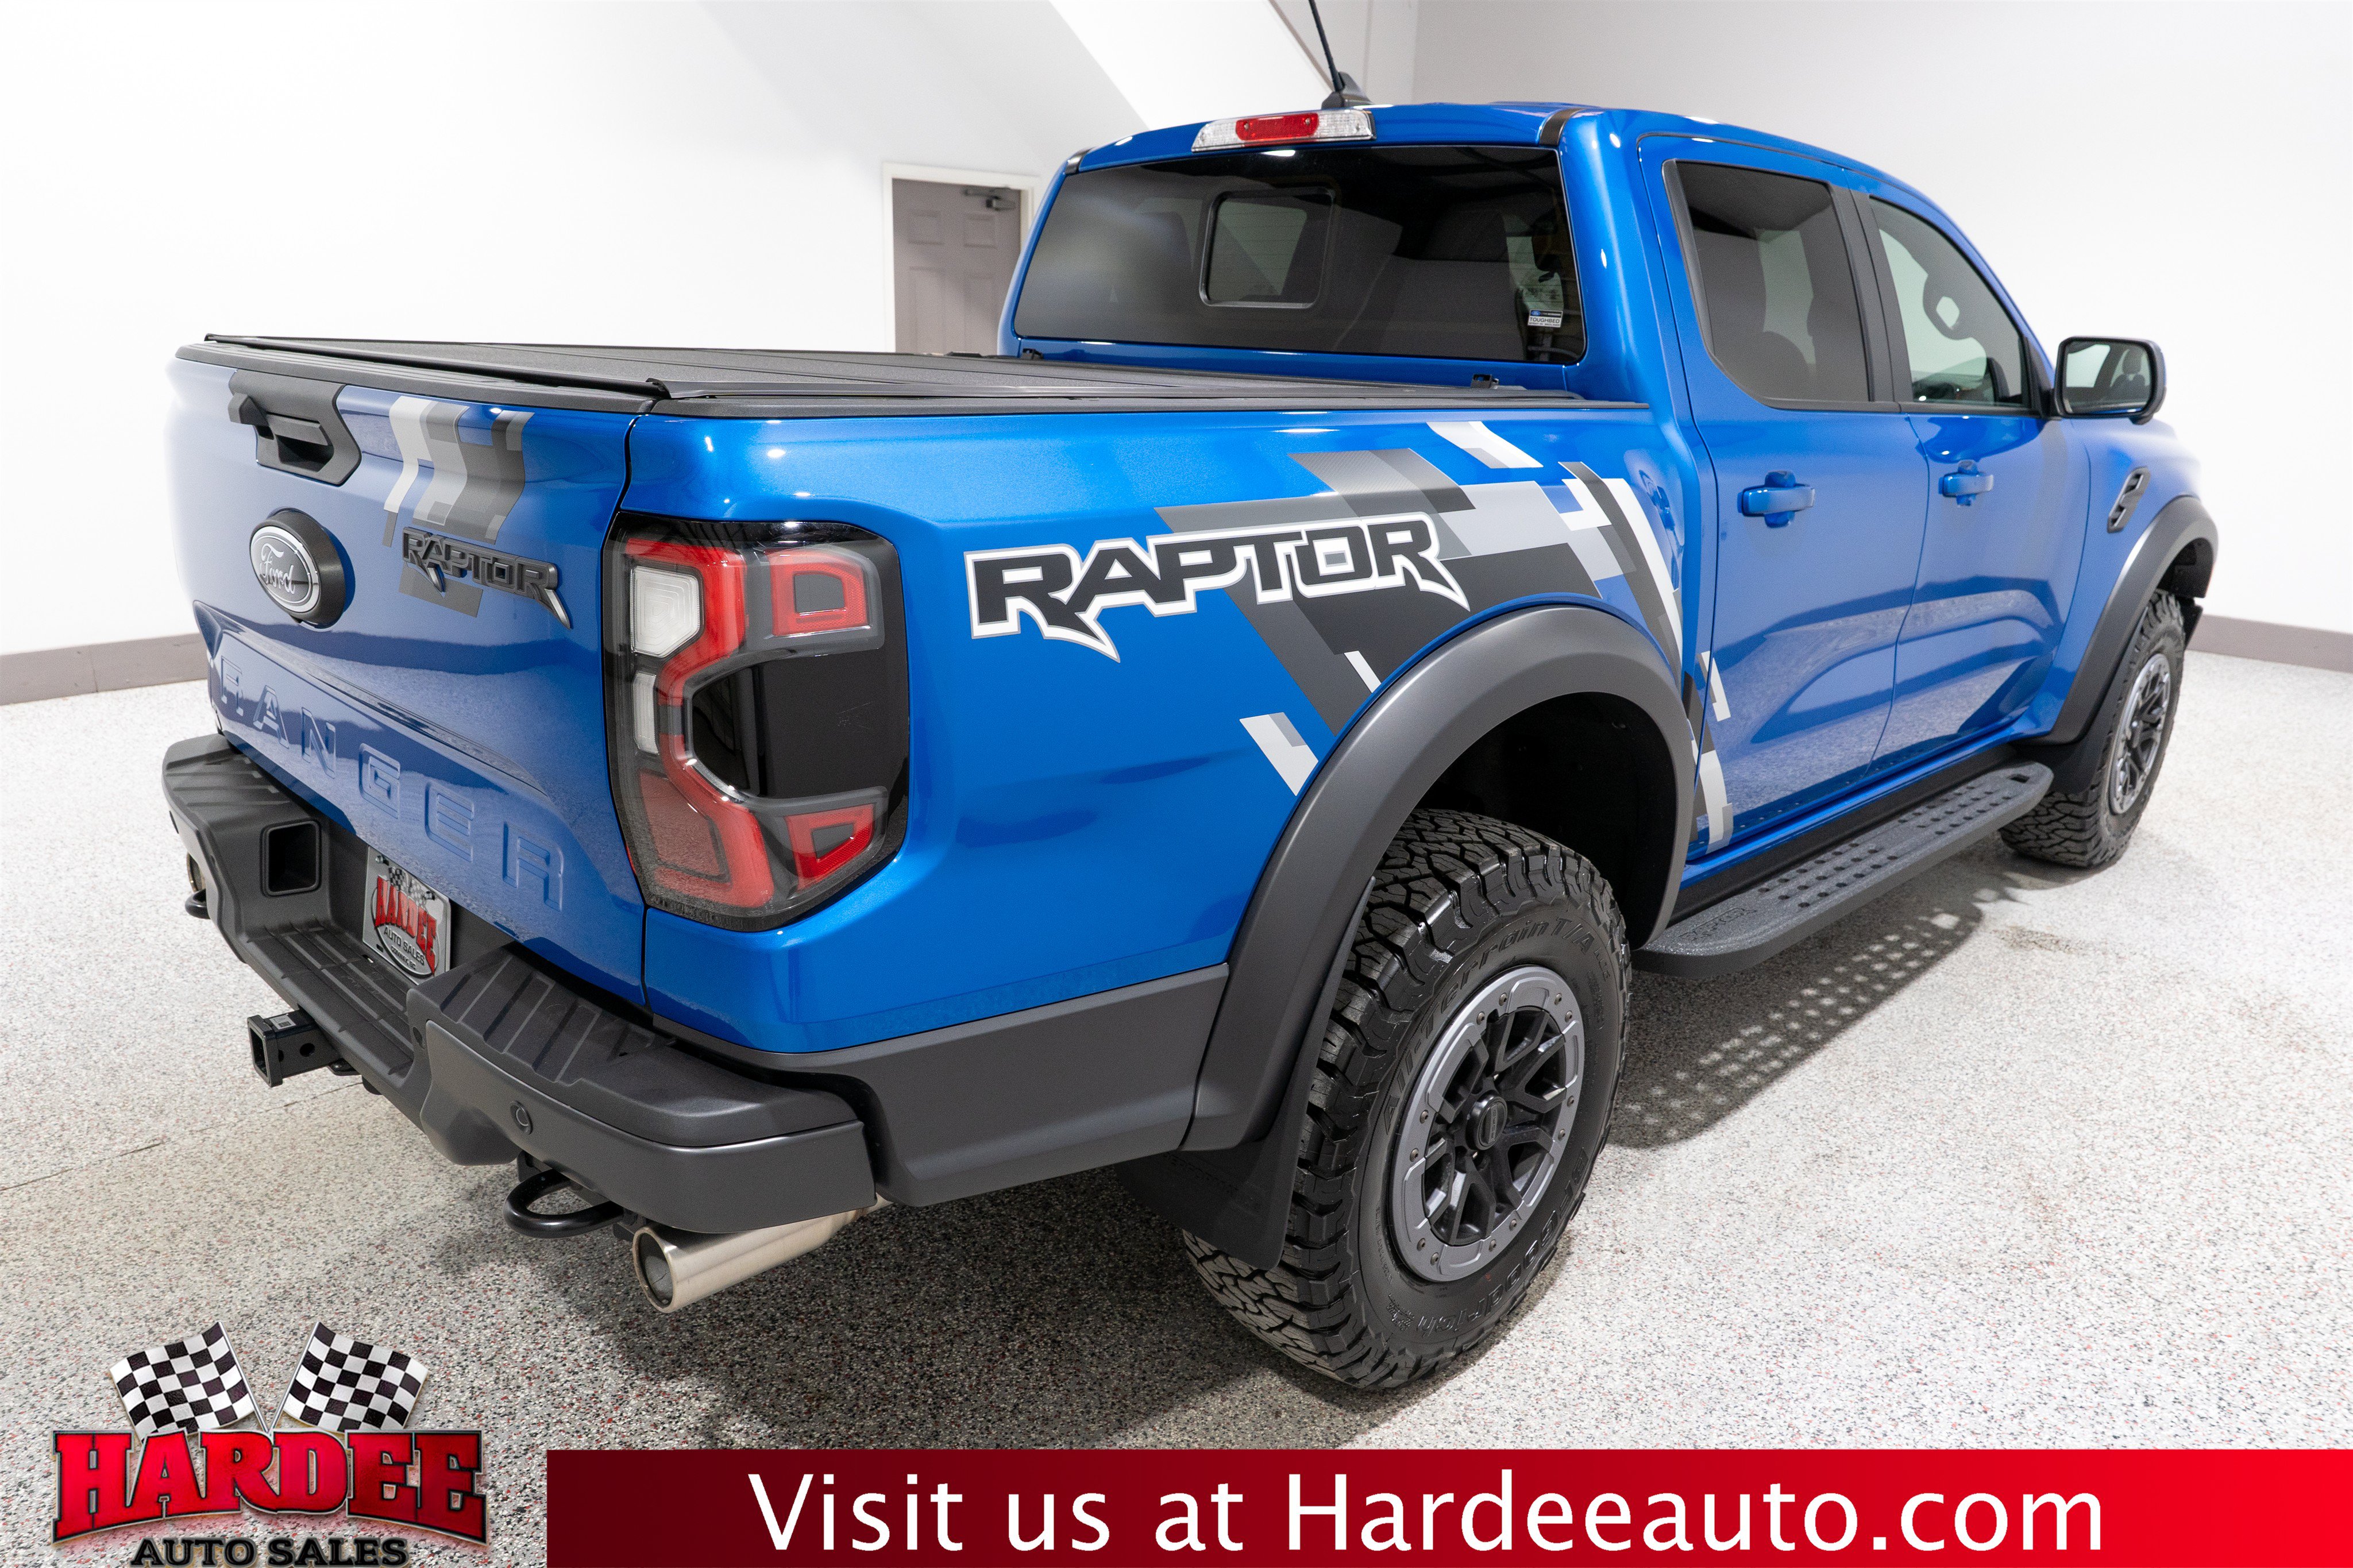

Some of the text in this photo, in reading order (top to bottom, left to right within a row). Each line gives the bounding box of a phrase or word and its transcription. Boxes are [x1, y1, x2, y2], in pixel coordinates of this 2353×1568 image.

[260, 542, 298, 594] Ford
[402, 526, 572, 629] RAPTOR
[964, 511, 1471, 663] RAPTOR
[220, 656, 565, 913] RANGER
[375, 875, 437, 975] HARDEE
[384, 926, 425, 967] AUTO SALES
[1383, 920, 1550, 1136] All-Terrain
[1550, 916, 1595, 955] T/A
